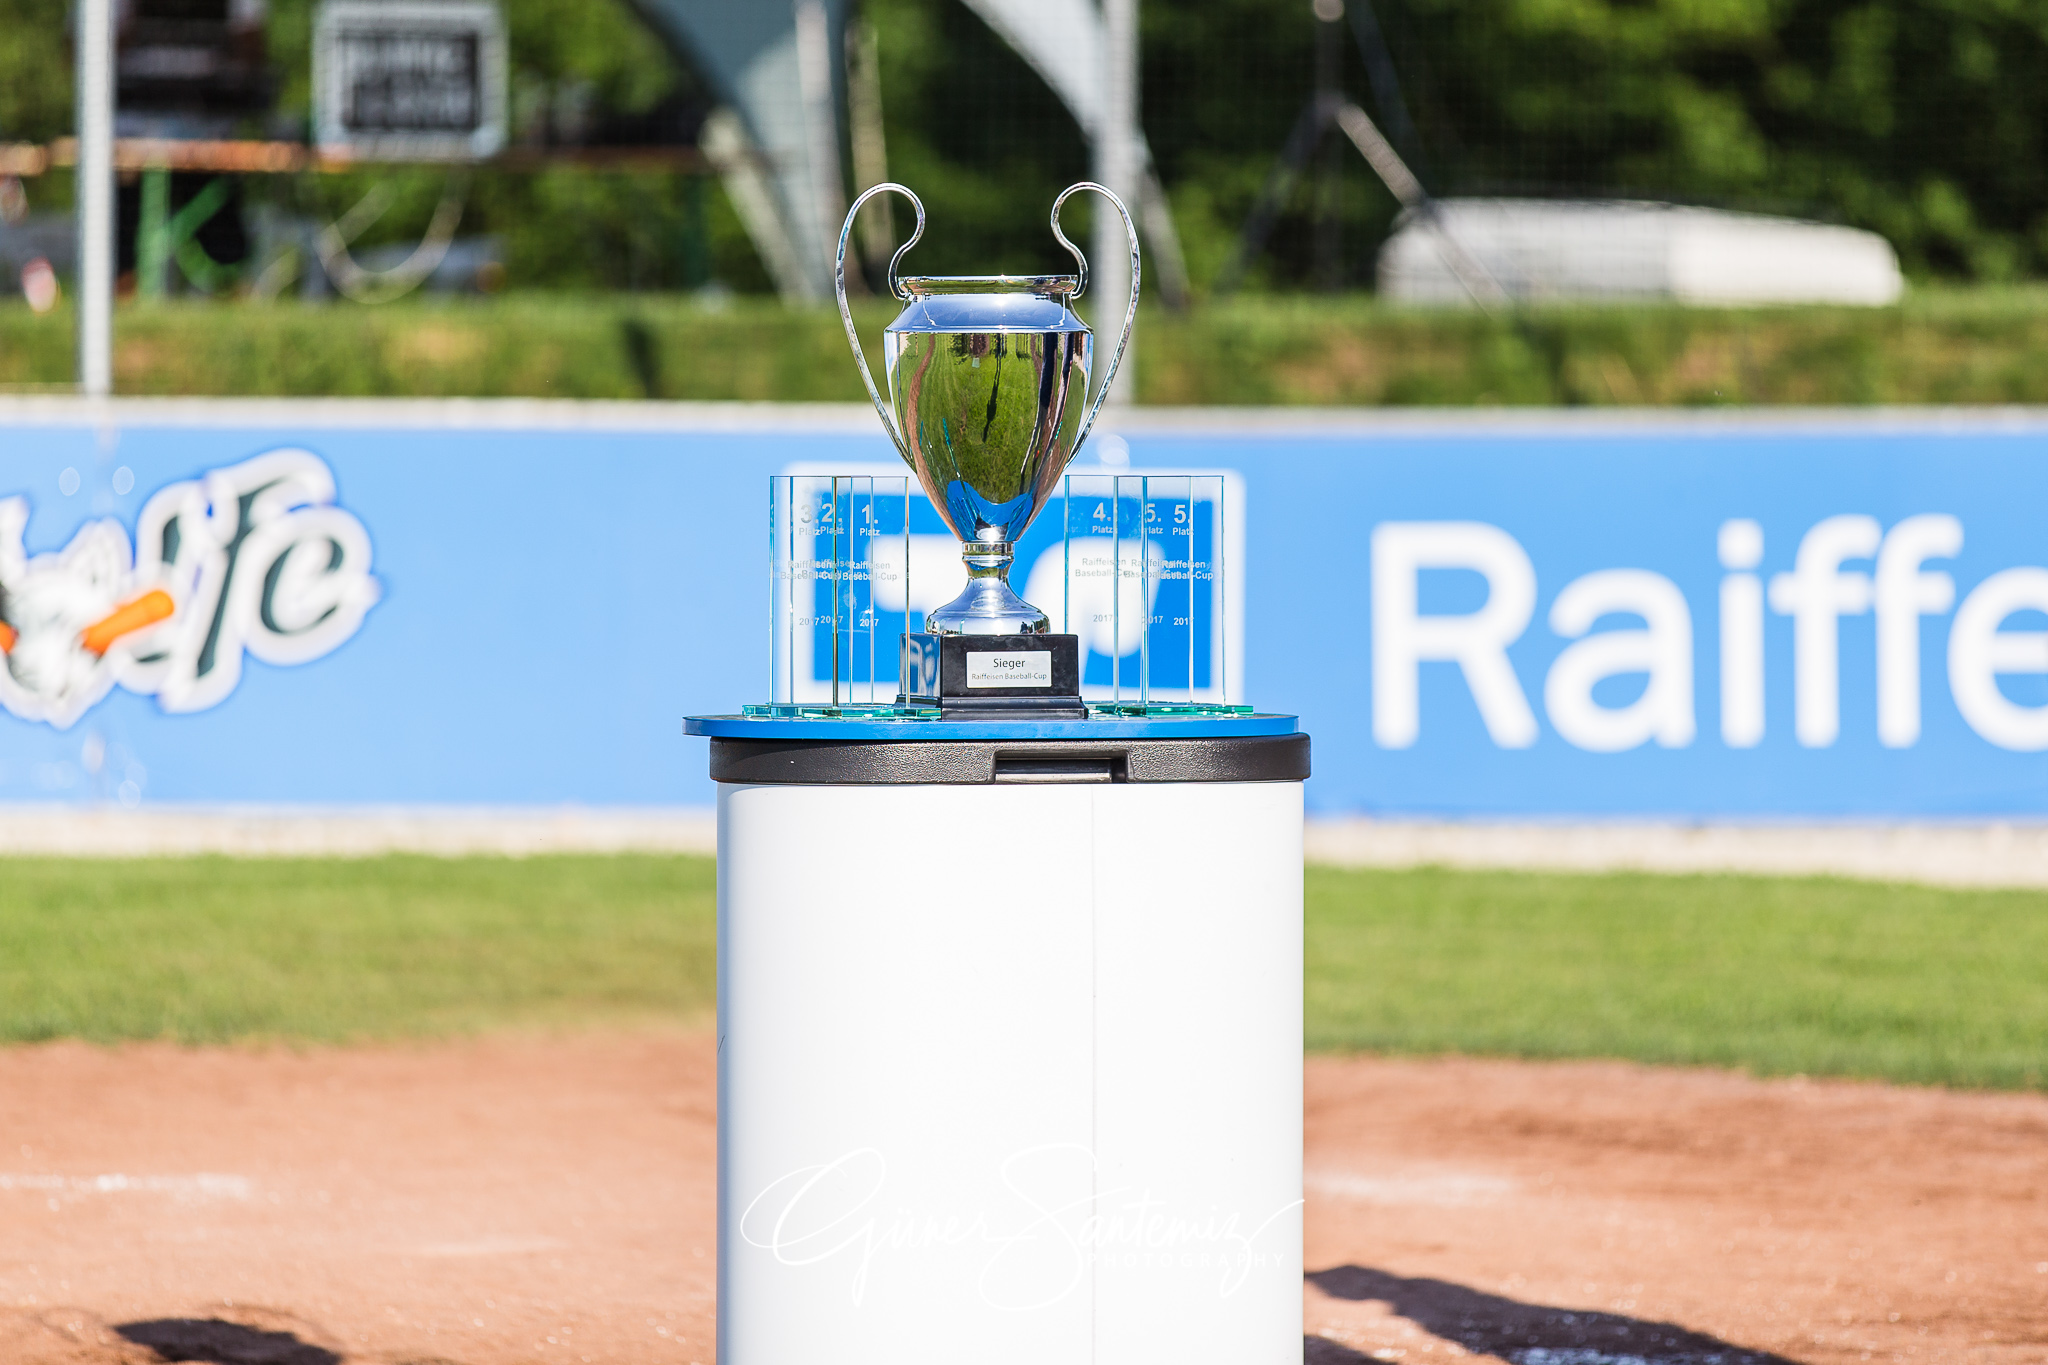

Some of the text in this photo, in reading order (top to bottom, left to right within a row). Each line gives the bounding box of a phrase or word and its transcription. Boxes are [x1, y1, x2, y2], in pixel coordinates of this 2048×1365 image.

[861, 504, 879, 524] 1.
[1092, 502, 1112, 522] 4.
[1174, 504, 1191, 524] 5.
[859, 527, 881, 537] Platz
[1091, 525, 1114, 534] Platz
[1144, 526, 1164, 535] latz
[820, 615, 844, 624] 207
[1369, 512, 2048, 755] Raiffe
[993, 658, 1026, 671] Sieger
[1004, 672, 1047, 681] Baseball-Cup
